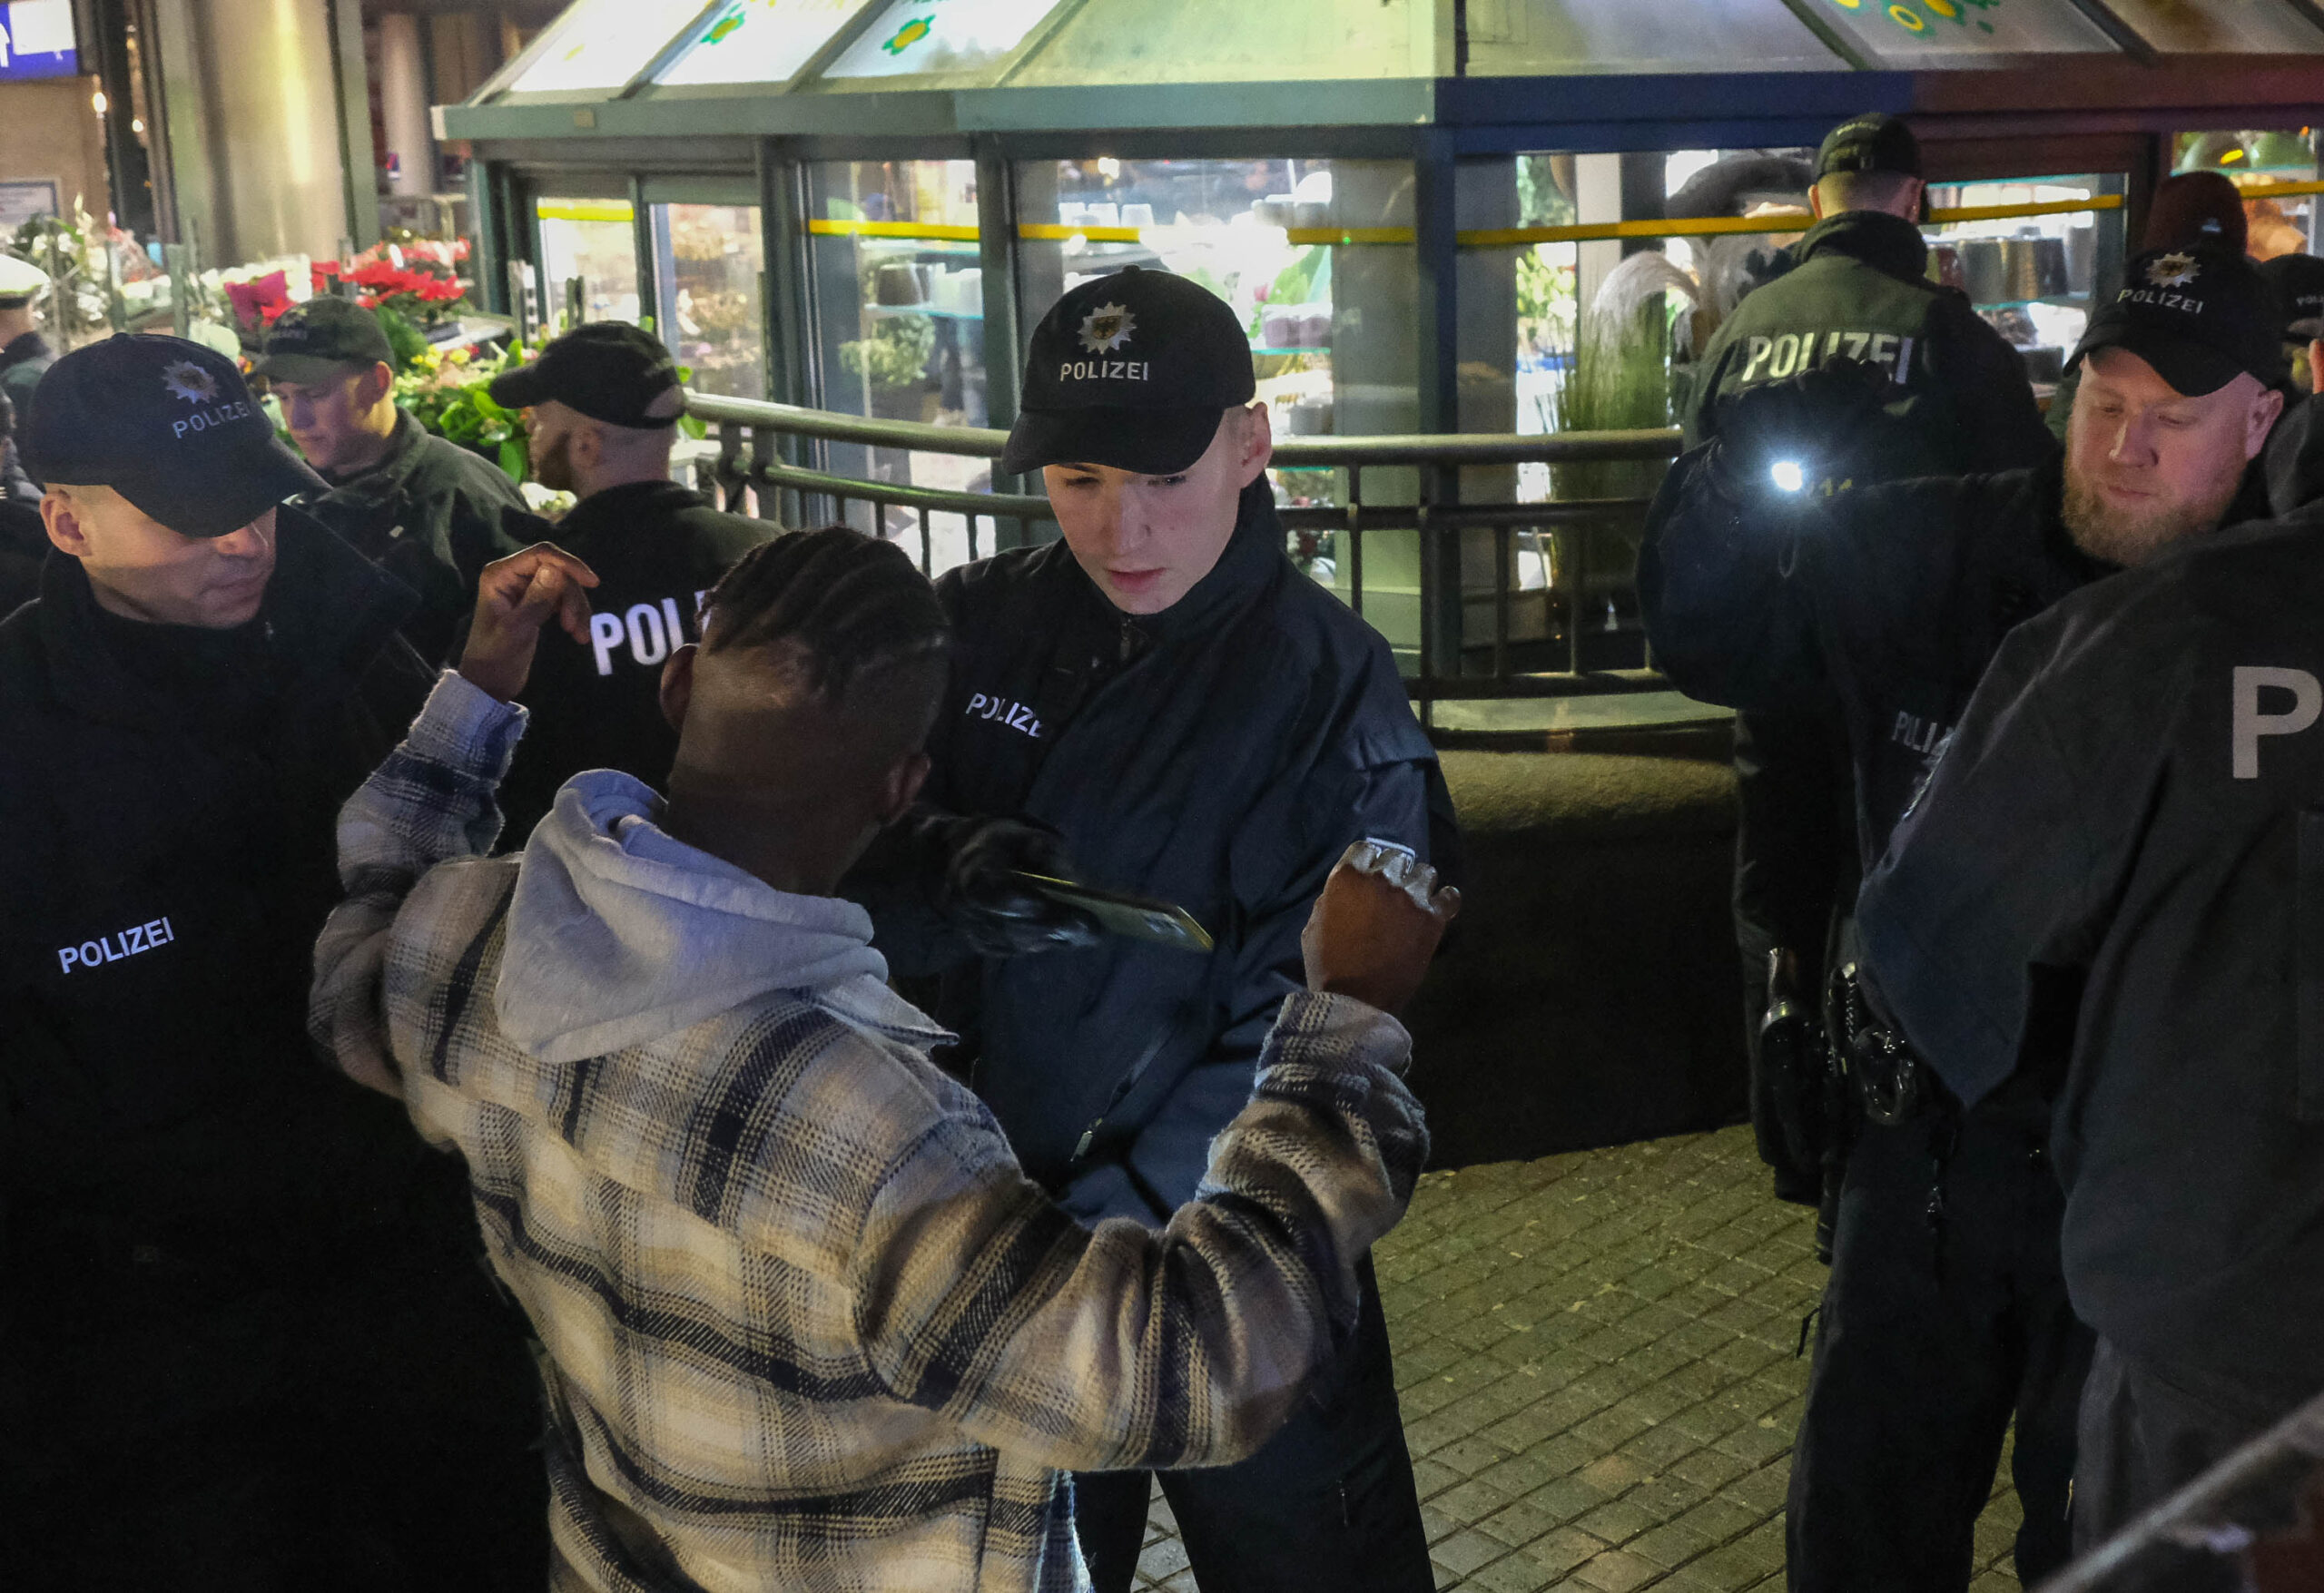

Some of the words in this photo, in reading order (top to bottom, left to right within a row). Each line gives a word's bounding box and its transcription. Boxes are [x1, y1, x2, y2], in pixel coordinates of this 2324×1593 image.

[2116, 289, 2204, 314] POLIZEI
[1059, 360, 1148, 382] POLIZEI
[2233, 666, 2323, 779] P
[58, 916, 174, 974] POLIZEI
